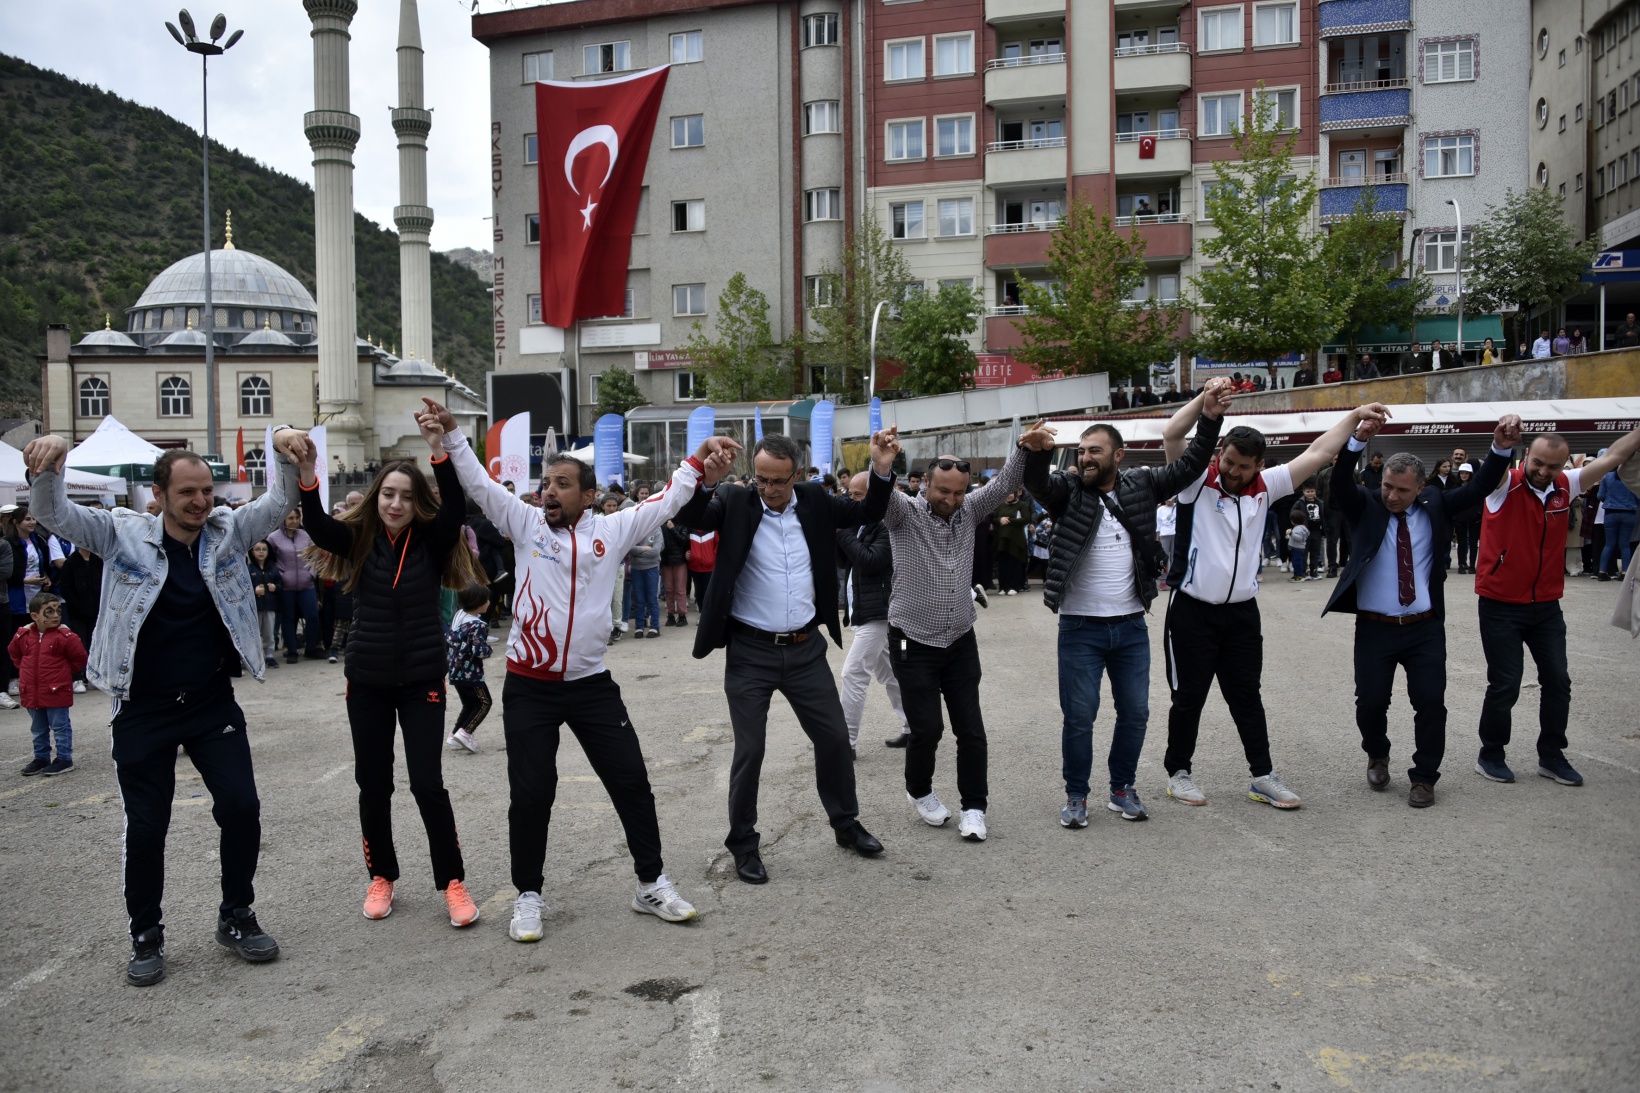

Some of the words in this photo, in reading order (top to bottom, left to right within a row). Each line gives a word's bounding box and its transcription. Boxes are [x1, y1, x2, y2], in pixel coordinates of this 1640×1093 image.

[491, 121, 503, 199] AKSOY
[493, 213, 504, 243] İŞ
[494, 256, 506, 366] MERKEZİ
[649, 352, 664, 361] İLİM
[1380, 344, 1409, 353] KİTAP
[67, 482, 109, 491] ÜNİVERSİTESİ
